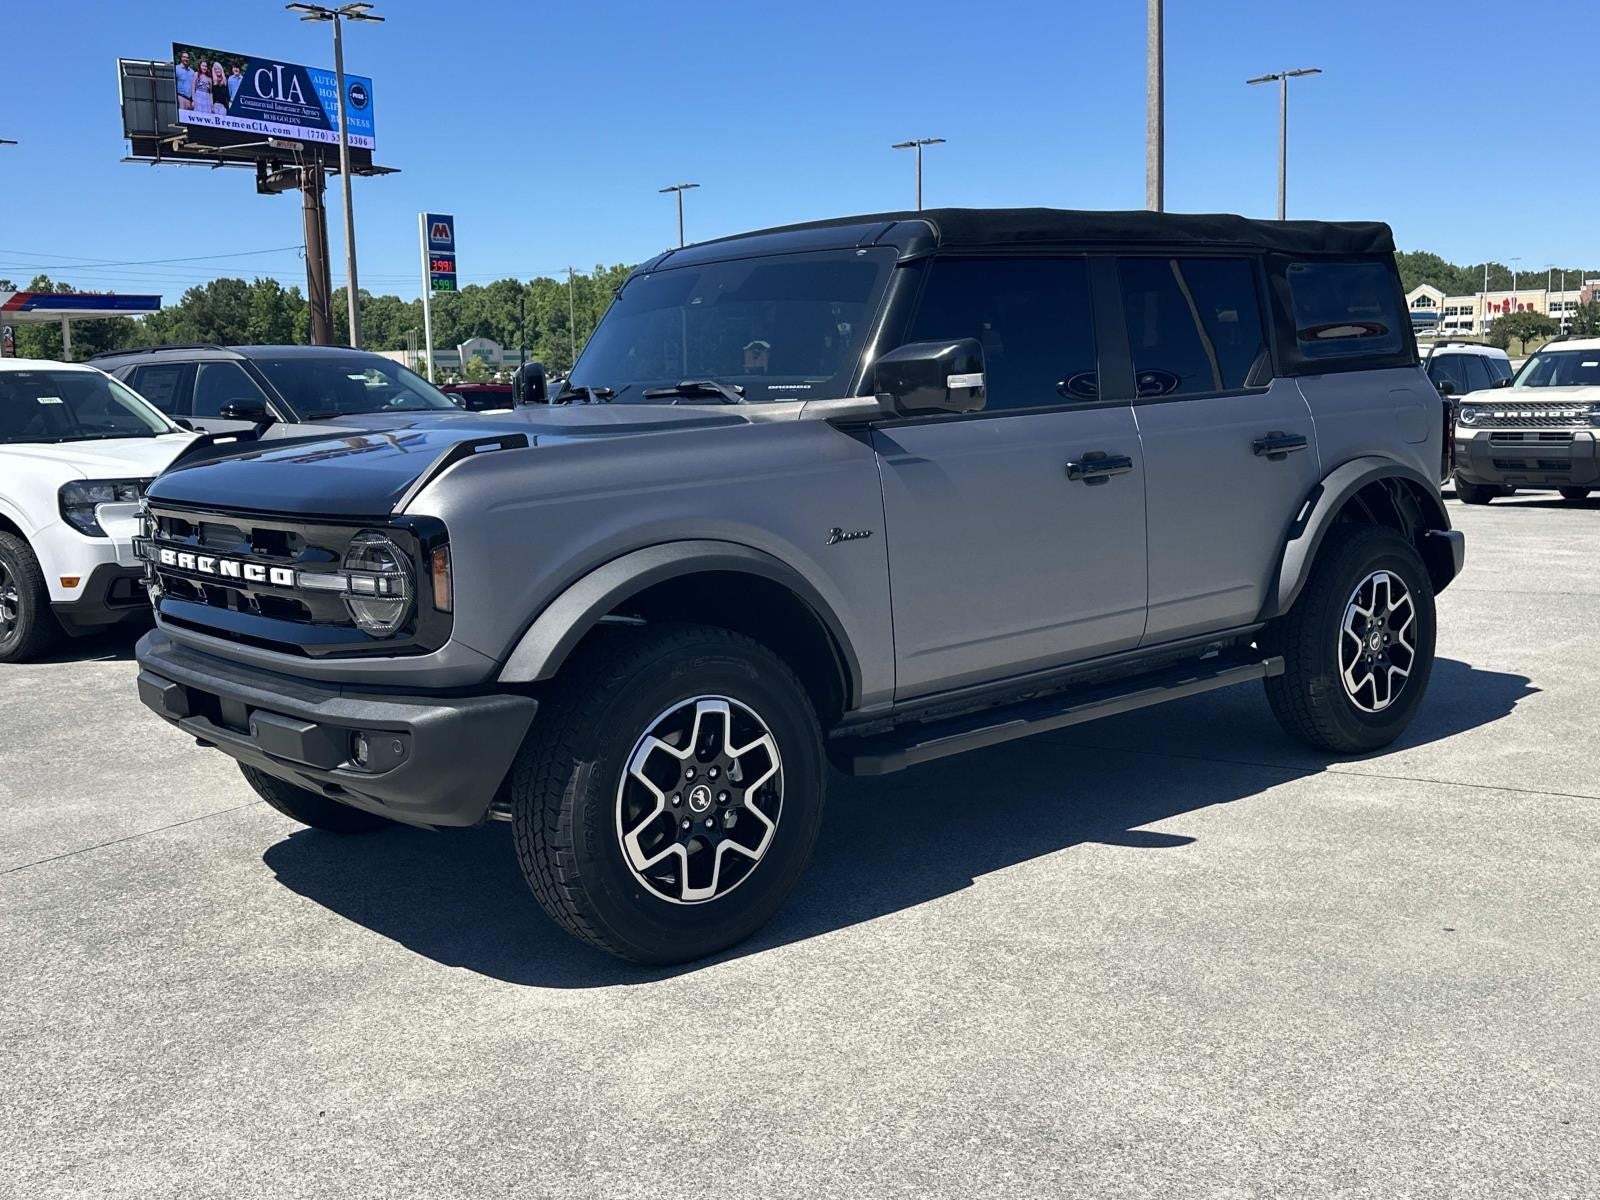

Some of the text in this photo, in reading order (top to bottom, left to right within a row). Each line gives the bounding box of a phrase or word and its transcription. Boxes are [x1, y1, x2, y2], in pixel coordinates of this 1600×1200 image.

[254, 65, 306, 104] CIA
[313, 75, 337, 86] AUTO
[240, 97, 320, 118] Commercial Insurance Agency
[325, 101, 339, 110] LIF
[188, 115, 291, 135] www.BremenCIA.com
[307, 129, 329, 141] (770)
[160, 549, 295, 586] BRONCO
